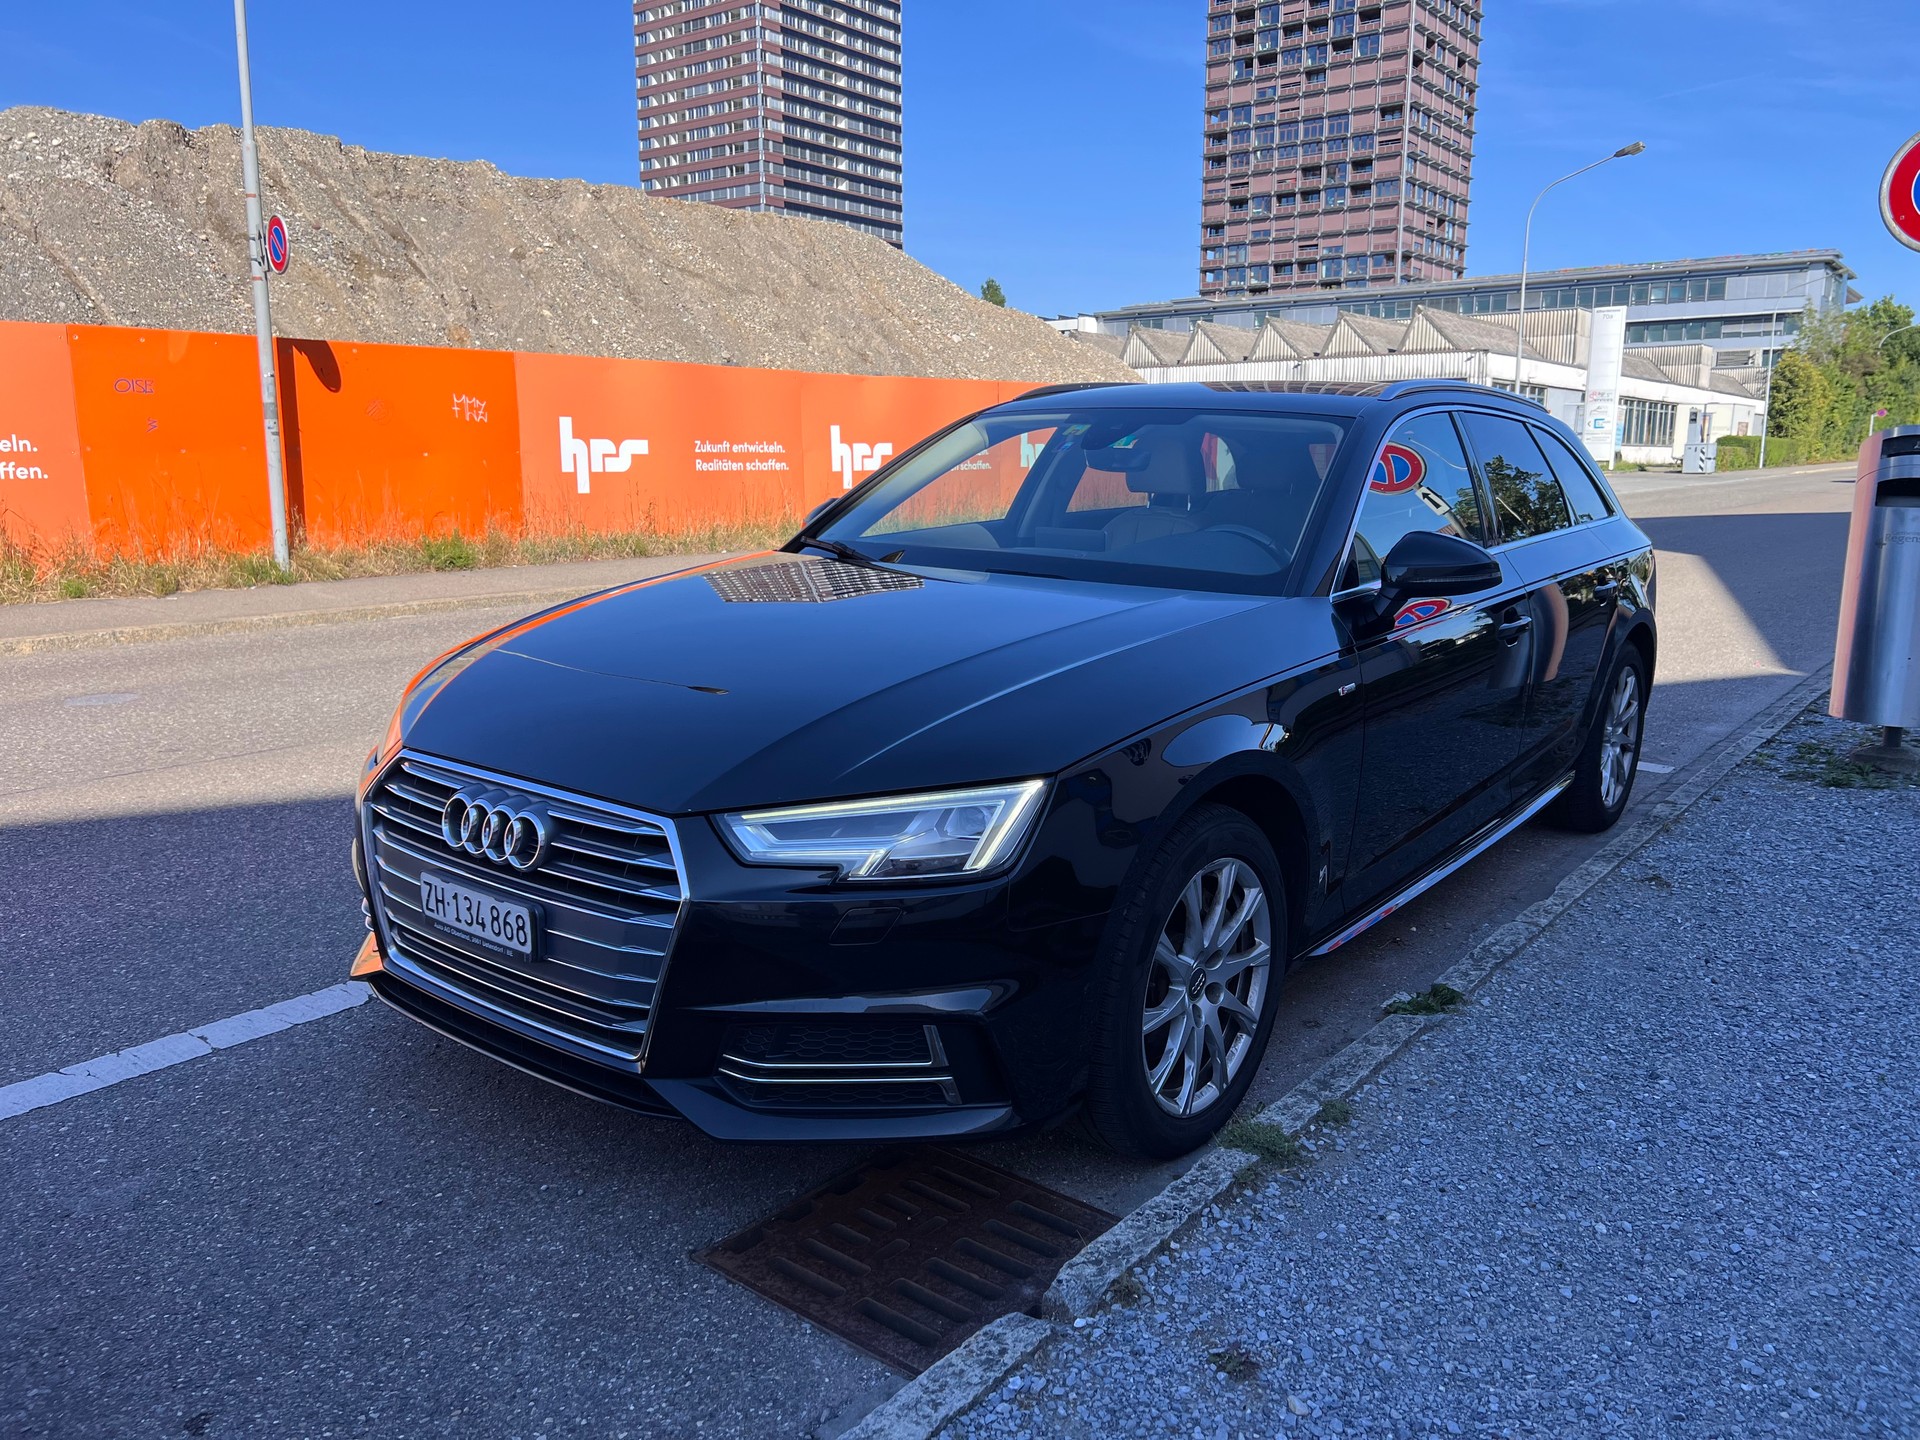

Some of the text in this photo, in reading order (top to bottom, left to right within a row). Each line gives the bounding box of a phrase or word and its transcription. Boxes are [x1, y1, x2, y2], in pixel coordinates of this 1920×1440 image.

[694, 440, 786, 453] Zukunft entwickeln.
[559, 416, 649, 494] hrs
[695, 458, 790, 471] Realitäten schaffen.
[960, 460, 992, 471] schaffen.
